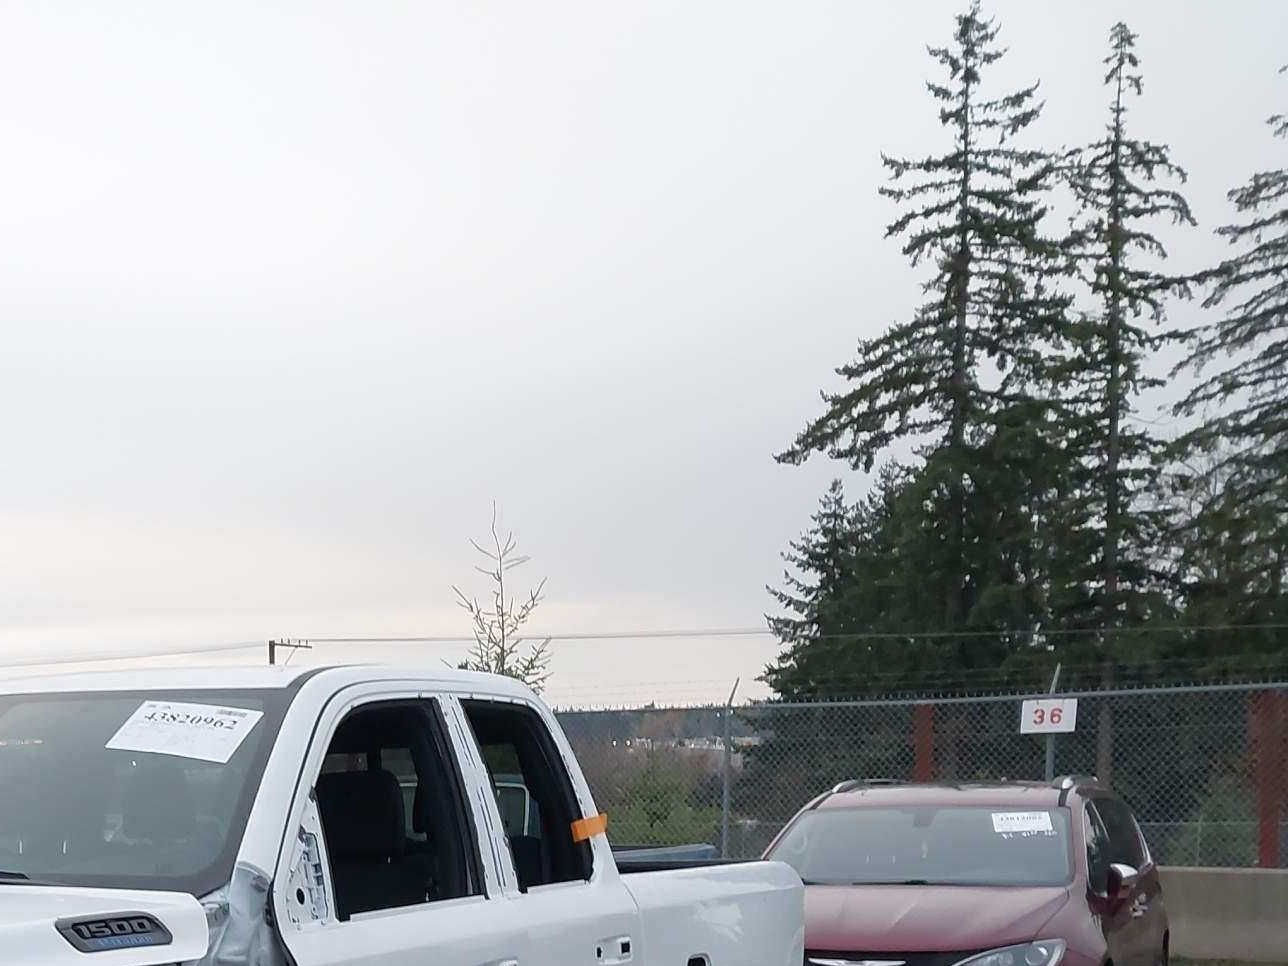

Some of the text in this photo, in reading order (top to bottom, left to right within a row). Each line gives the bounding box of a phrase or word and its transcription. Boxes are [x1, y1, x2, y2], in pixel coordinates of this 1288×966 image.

[144, 711, 238, 730] 43820962
[1033, 708, 1063, 725] 36
[72, 919, 152, 938] 1500
